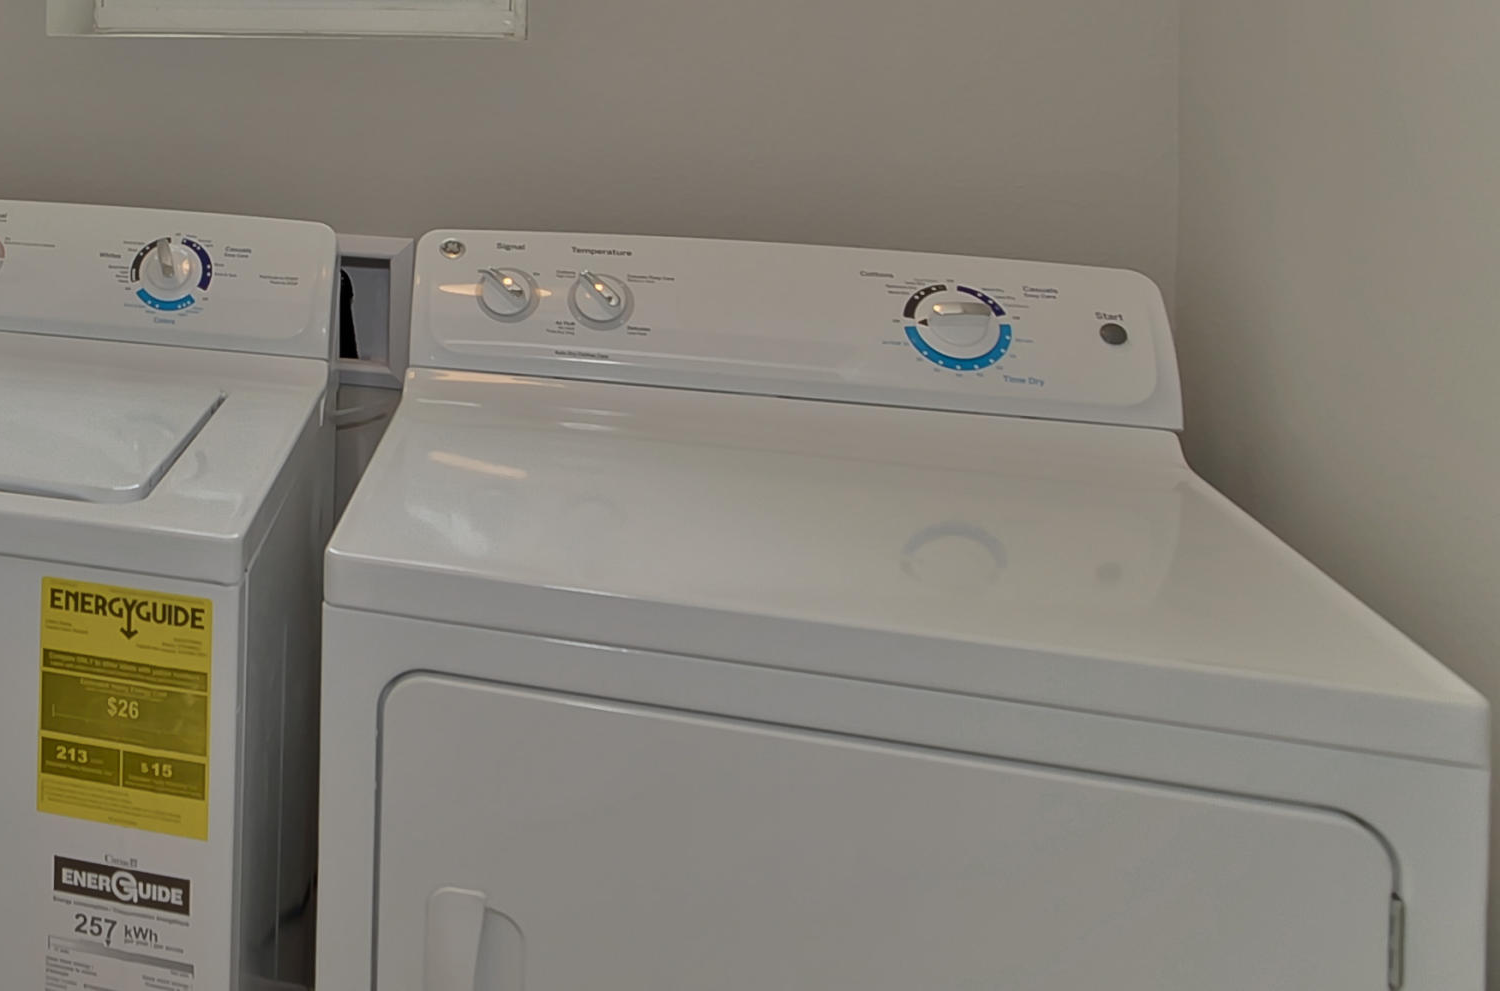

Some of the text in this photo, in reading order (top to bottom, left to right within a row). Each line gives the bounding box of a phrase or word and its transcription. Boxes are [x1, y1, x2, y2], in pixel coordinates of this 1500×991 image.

[496, 242, 525, 251] Signal
[571, 246, 632, 257] Temperature
[1095, 311, 1124, 322] Start
[1003, 374, 1045, 387] Time Dry
[49, 587, 205, 631] ENERGYGUIDE
[107, 695, 139, 719] $26
[55, 745, 88, 764] 213
[61, 866, 184, 905] ENERGUIDE
[74, 912, 117, 939] 257
[123, 923, 159, 944] kWh
